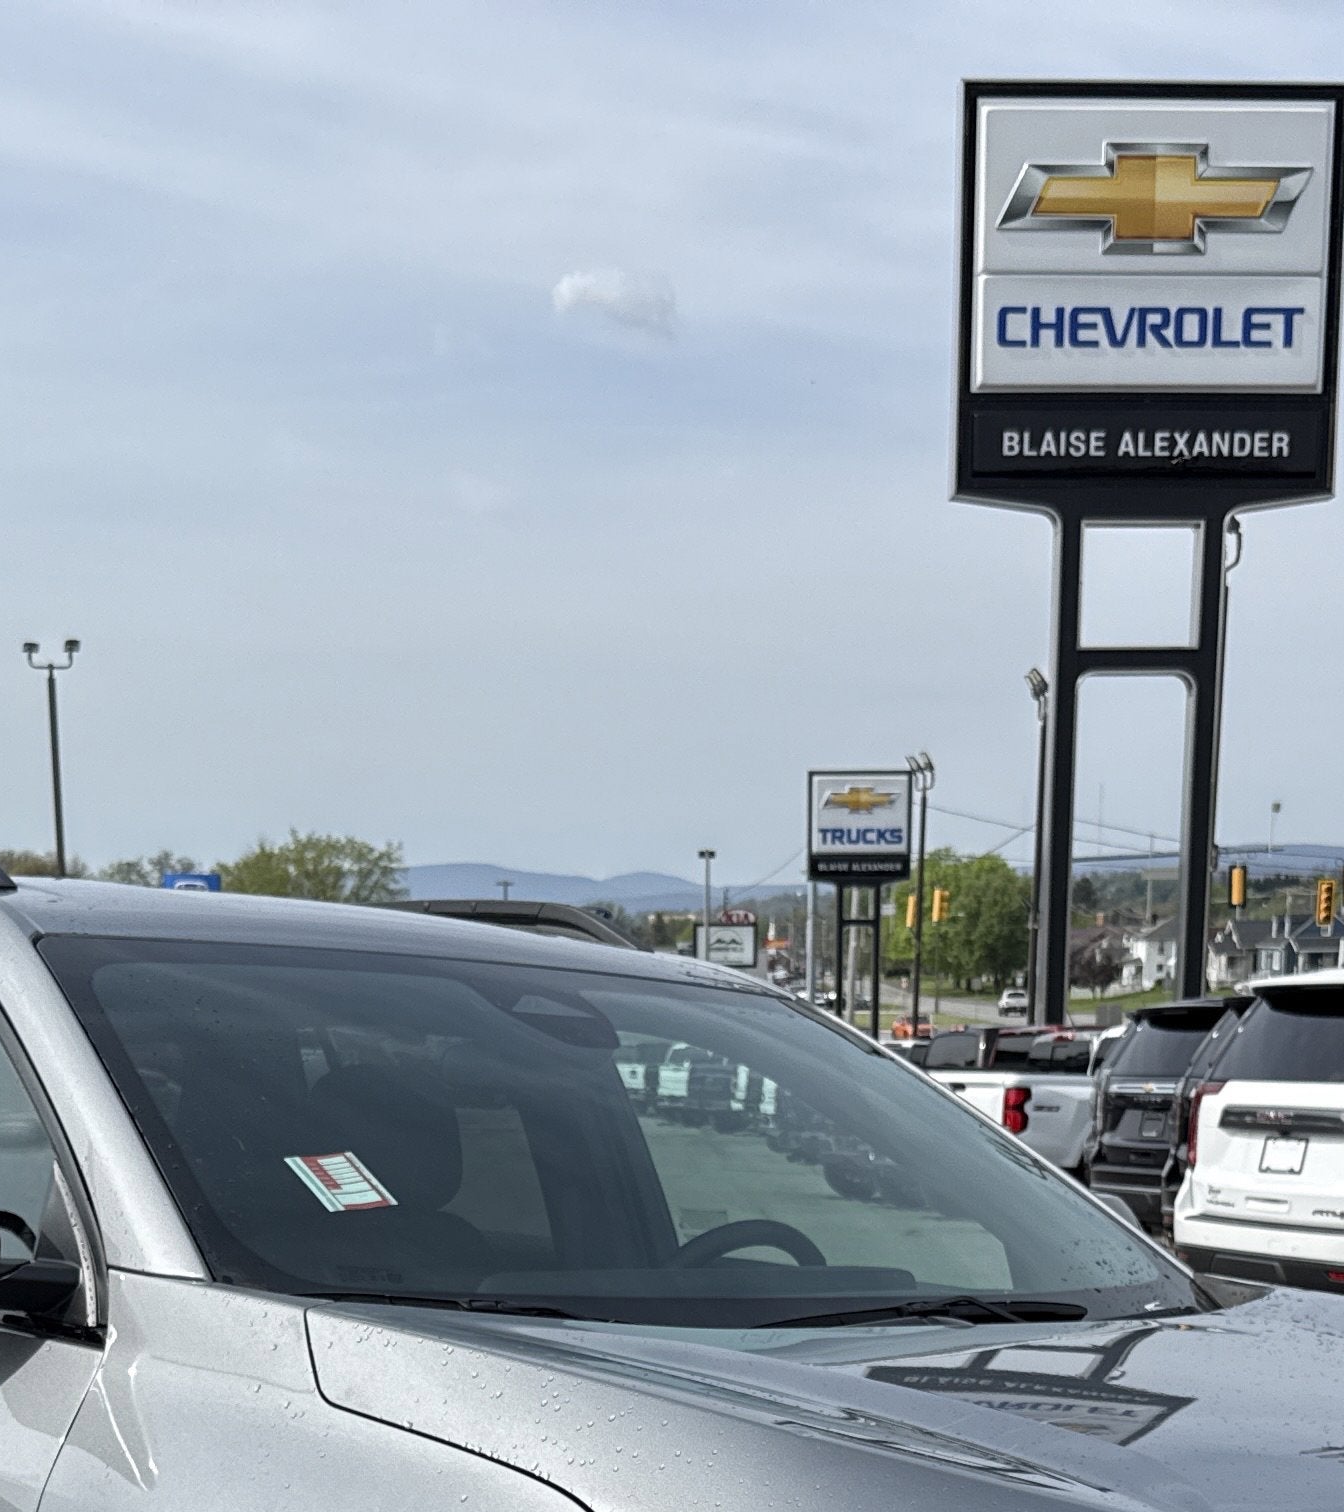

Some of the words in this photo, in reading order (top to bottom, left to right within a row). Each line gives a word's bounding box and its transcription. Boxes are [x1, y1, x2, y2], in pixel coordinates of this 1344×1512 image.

[996, 306, 1305, 350] CHEVROLET
[1001, 430, 1107, 458] BLAISE
[1117, 431, 1291, 459] ALEXANDER
[817, 827, 904, 846] TRUCKS
